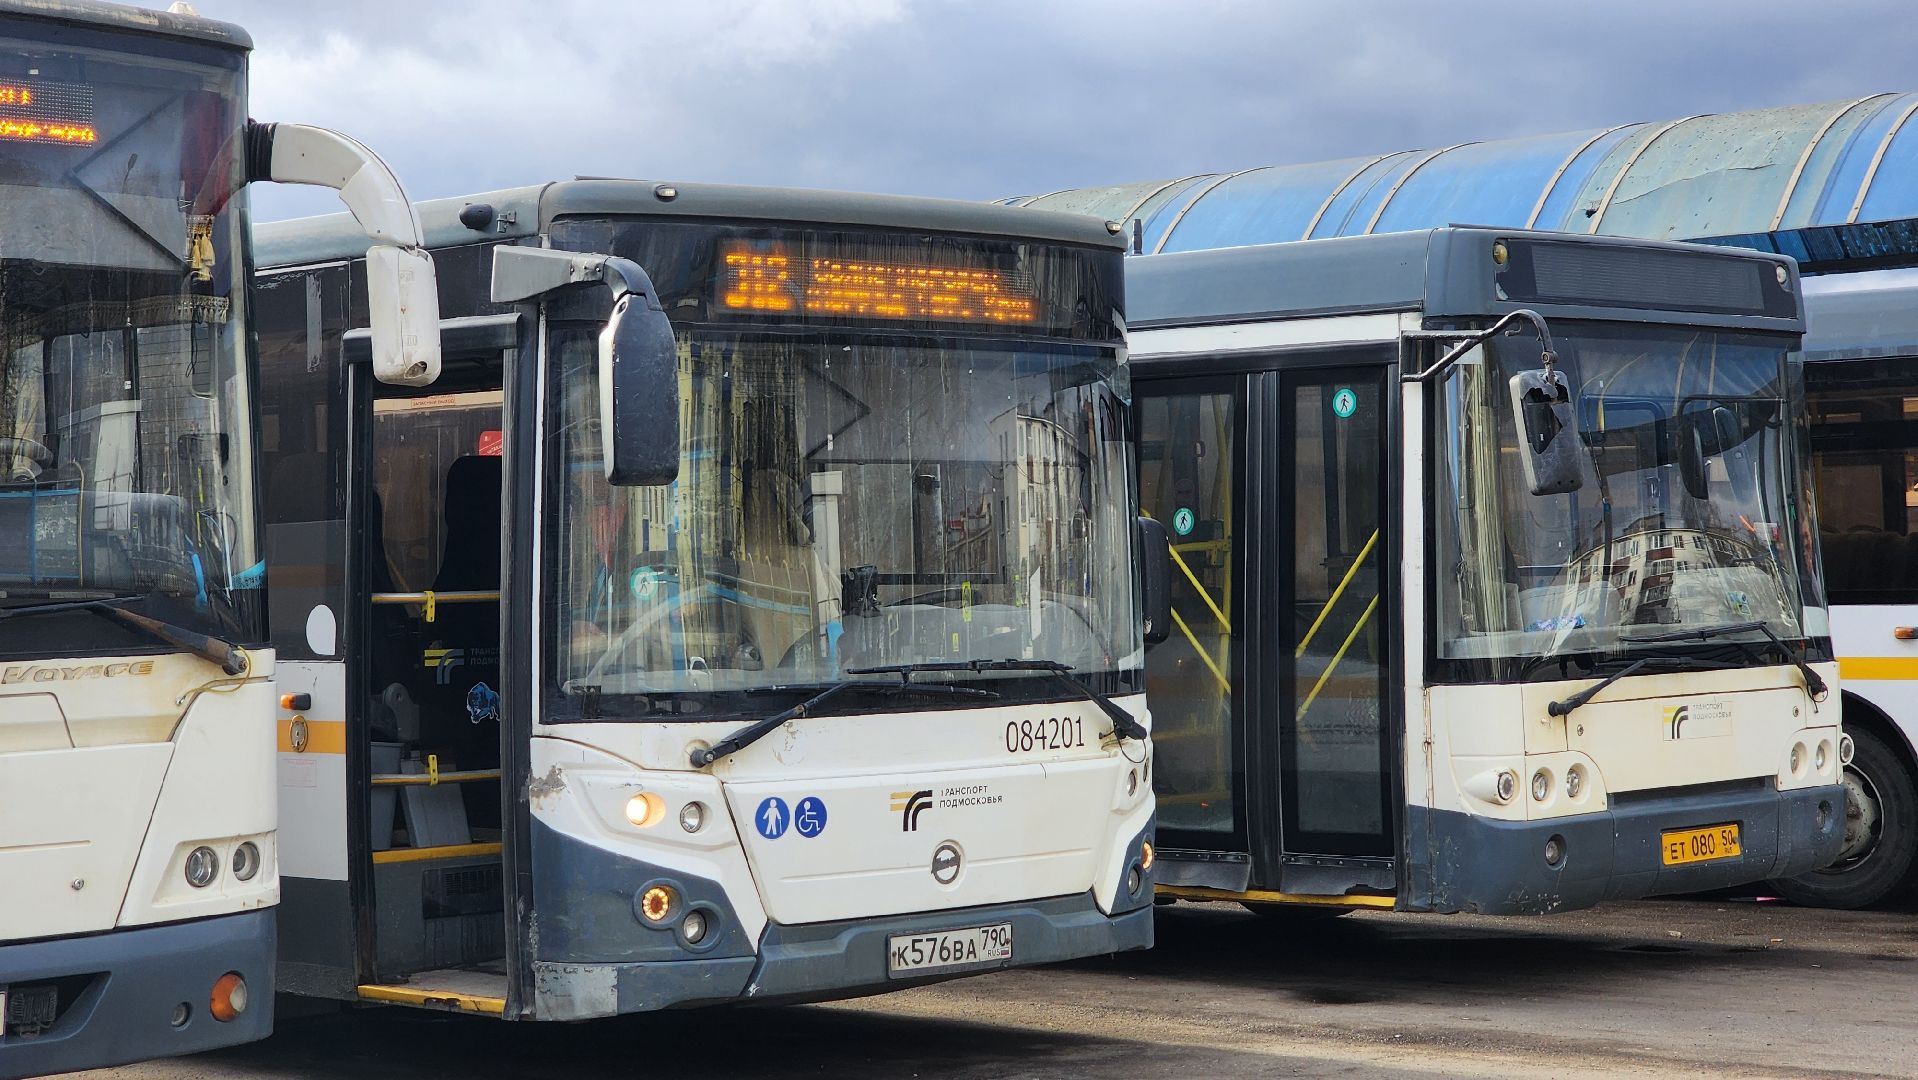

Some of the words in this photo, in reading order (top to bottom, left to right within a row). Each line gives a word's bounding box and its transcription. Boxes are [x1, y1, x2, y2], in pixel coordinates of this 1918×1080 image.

[1006, 716, 1085, 753] 084201
[1691, 833, 1716, 856] 080
[981, 926, 1008, 950] 790
[987, 948, 1001, 957] RUS
